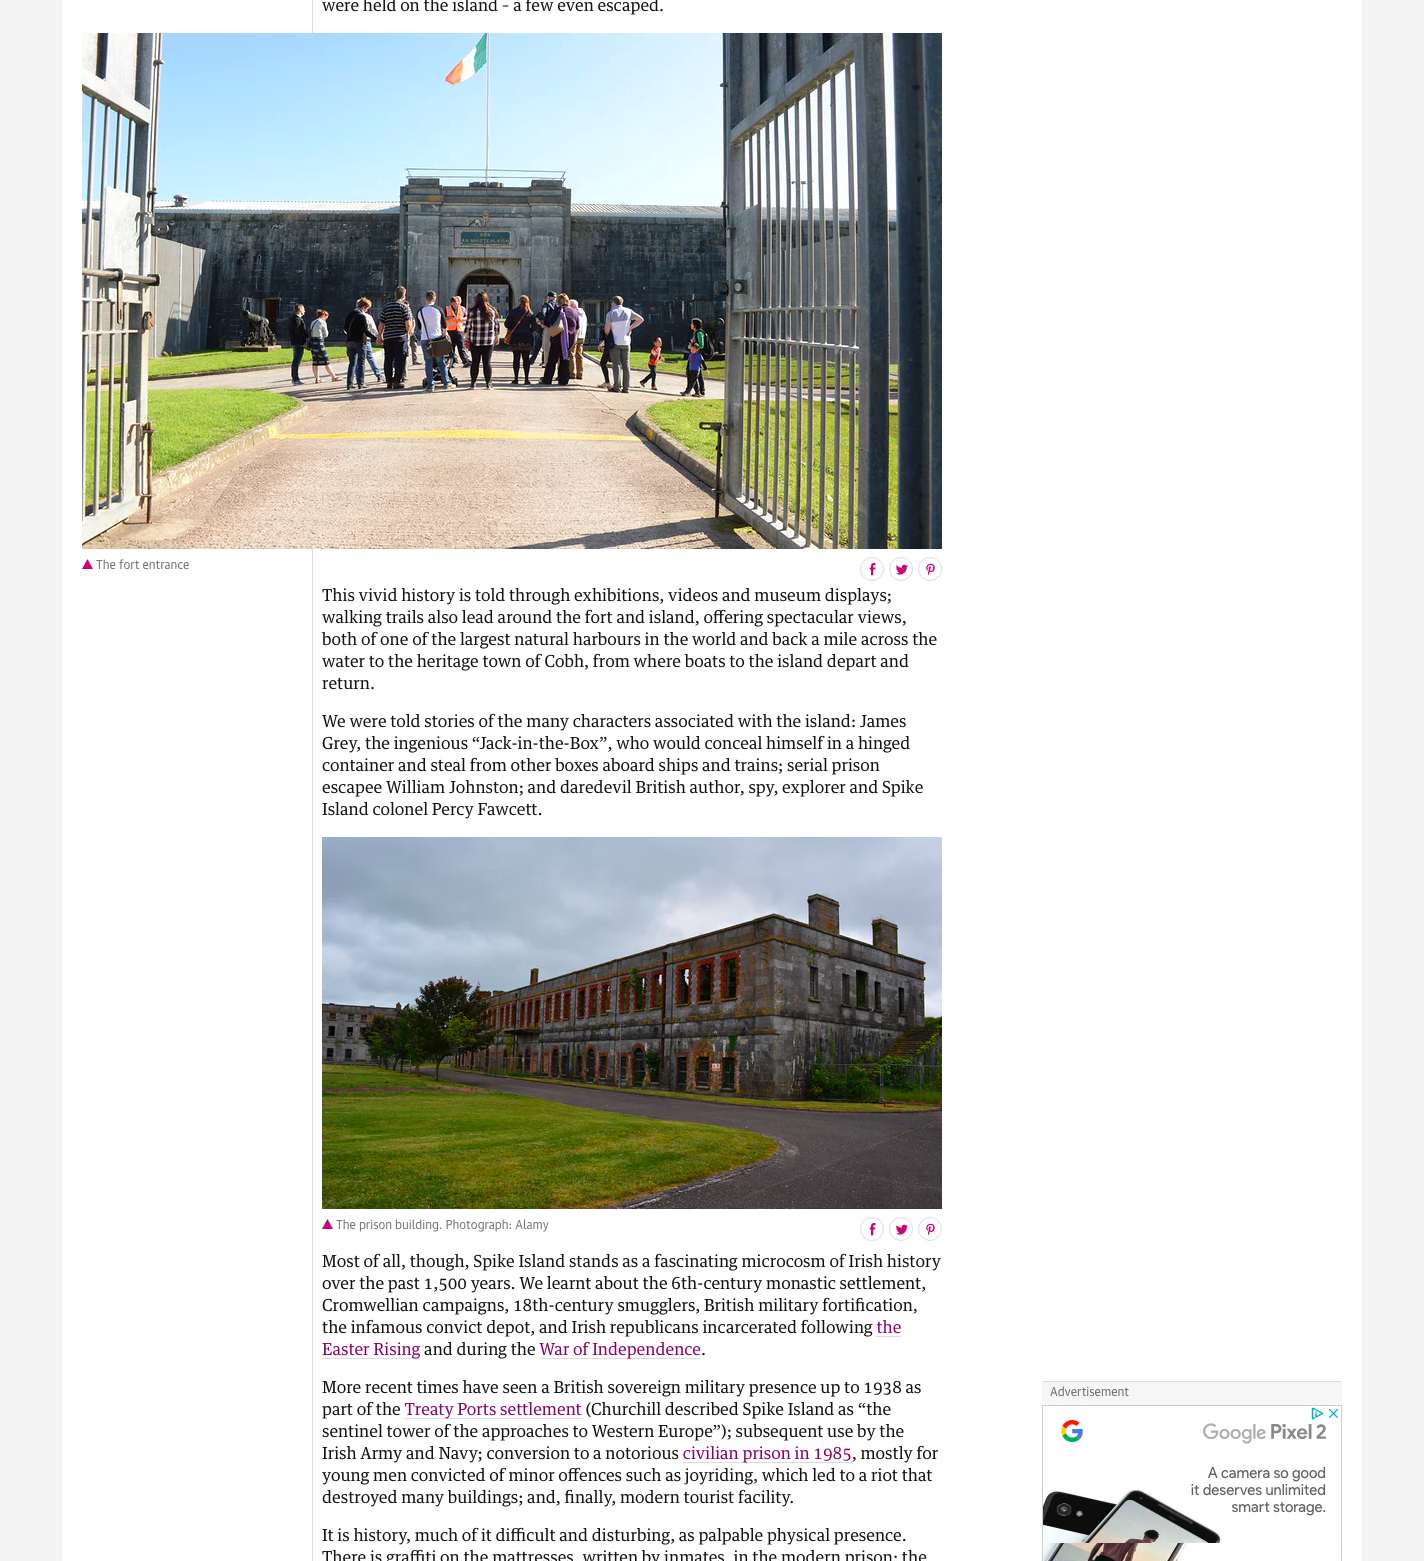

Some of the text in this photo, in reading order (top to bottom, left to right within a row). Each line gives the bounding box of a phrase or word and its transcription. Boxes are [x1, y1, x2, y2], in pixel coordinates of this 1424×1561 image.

[95, 559, 189, 569] The fort entrance
[335, 1219, 549, 1232] The prison building. Photograph: Alamy
